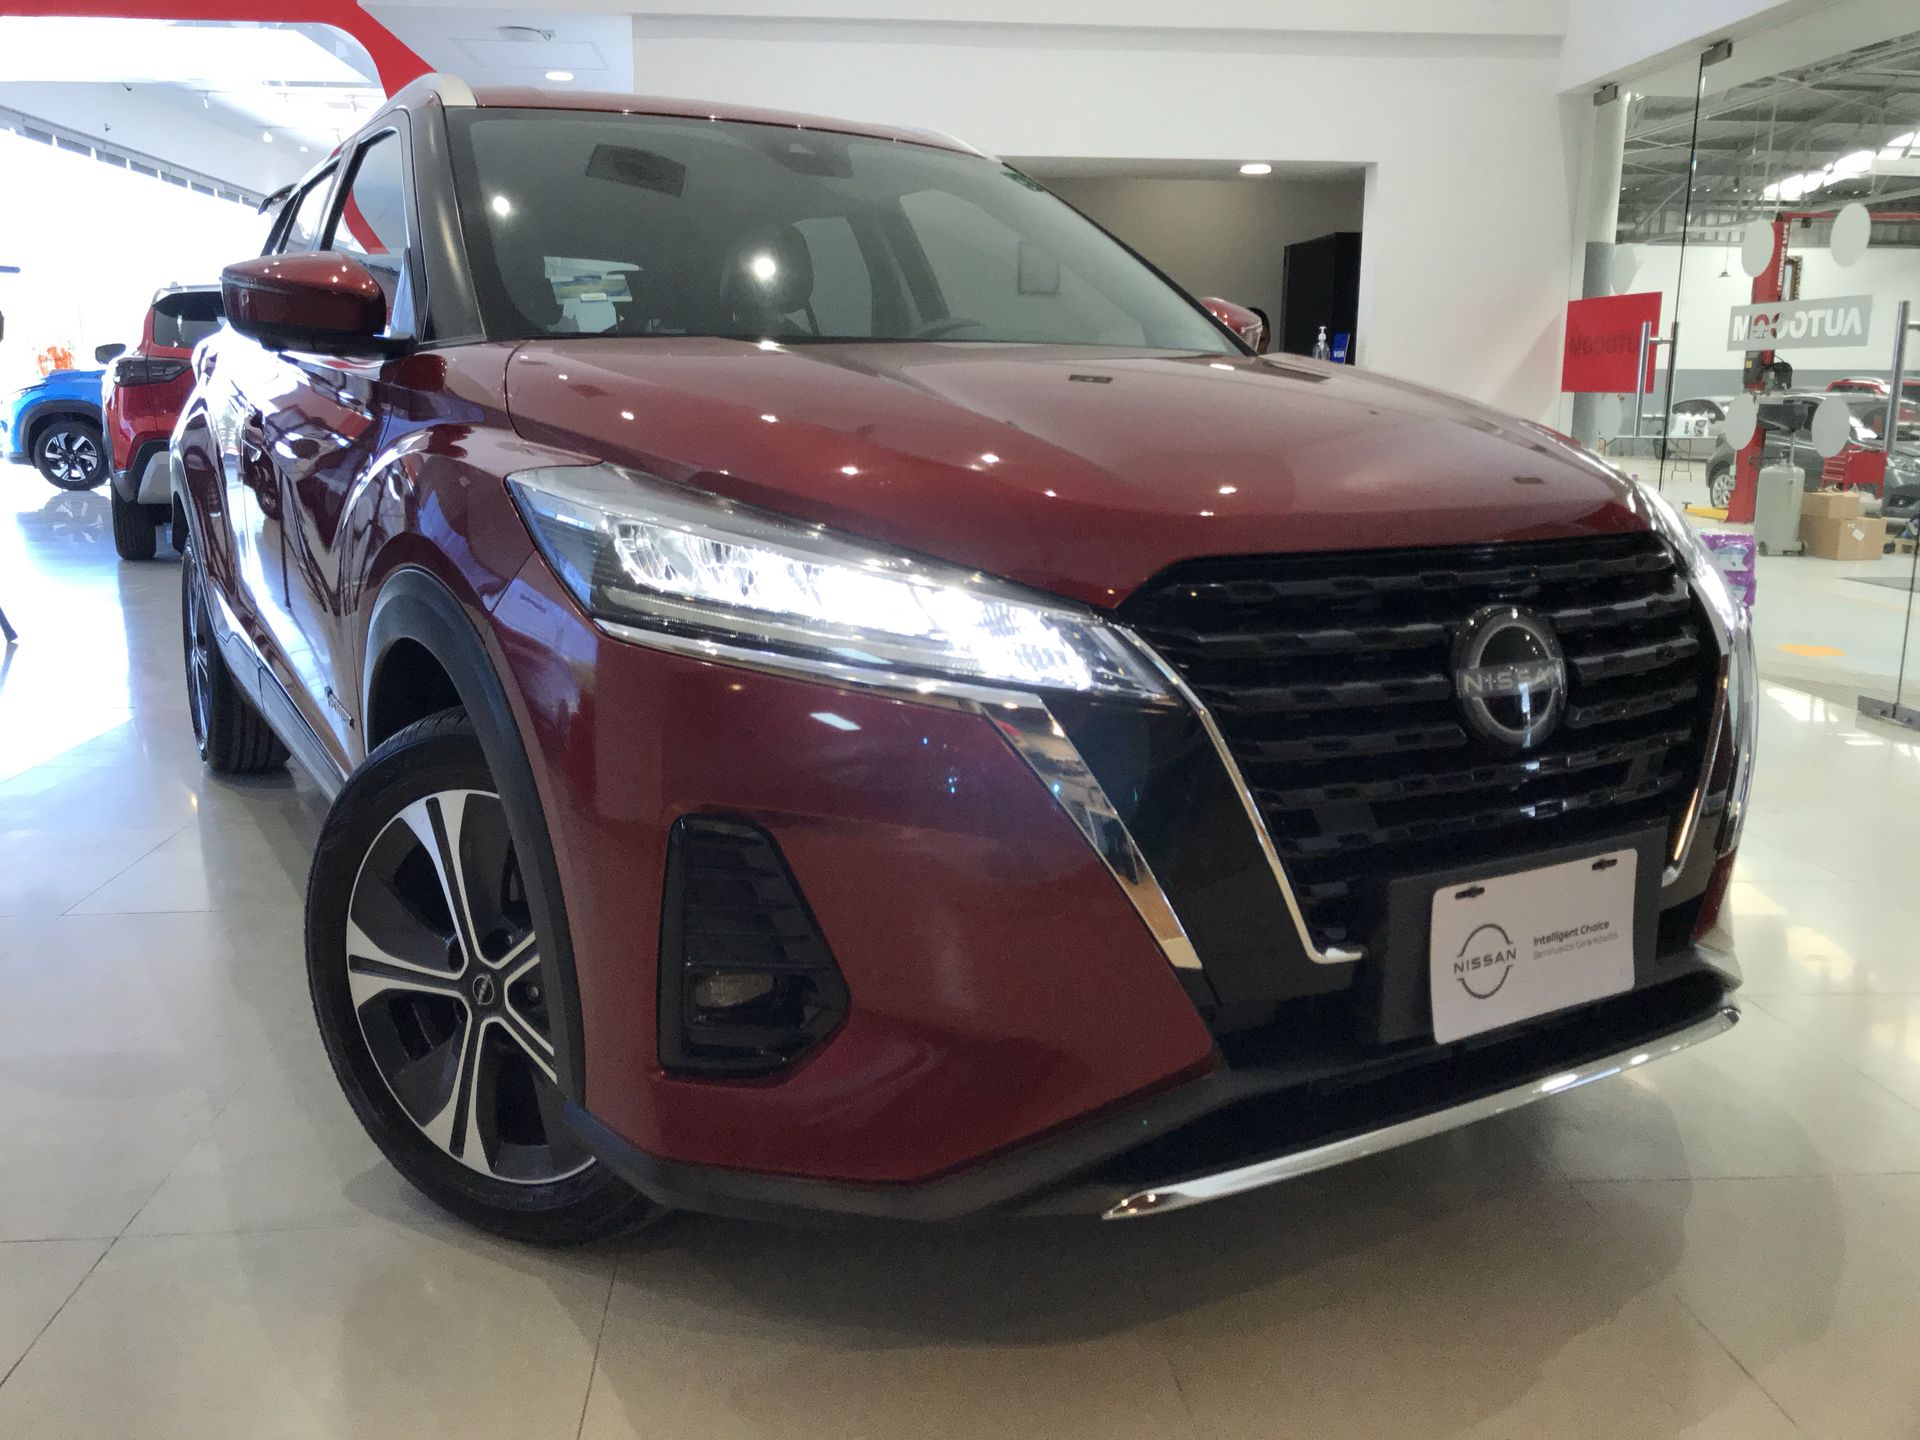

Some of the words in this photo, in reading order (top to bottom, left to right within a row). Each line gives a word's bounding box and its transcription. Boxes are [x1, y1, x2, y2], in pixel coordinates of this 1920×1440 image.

[1533, 927, 1579, 947] Intelligent
[1580, 921, 1610, 935] Choice
[1454, 948, 1517, 975] NISSAN
